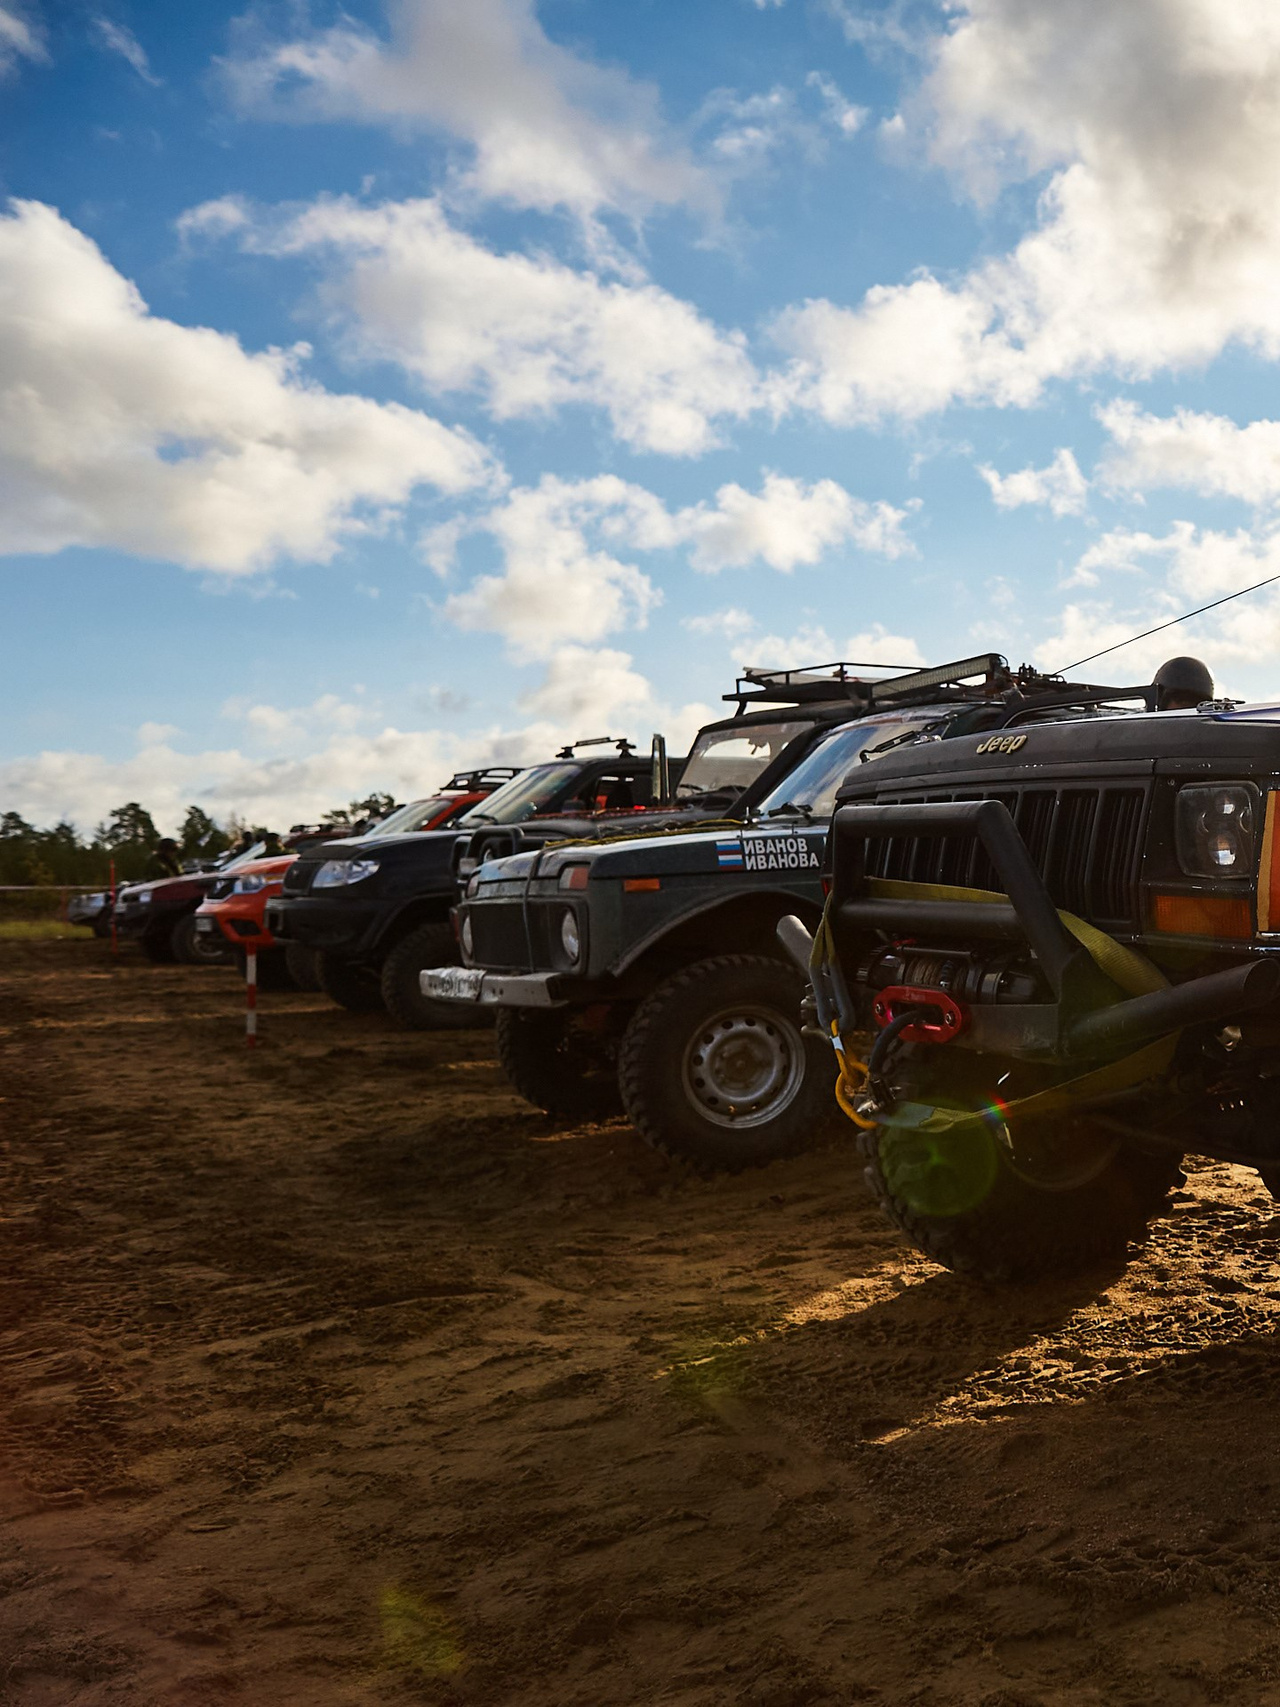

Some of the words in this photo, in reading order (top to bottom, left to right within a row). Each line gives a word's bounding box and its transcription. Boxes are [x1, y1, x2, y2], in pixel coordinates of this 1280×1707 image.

[976, 734, 1027, 754] Jeep
[743, 838, 808, 855] ИВАНОВ
[745, 852, 820, 871] ИВАНОВА
